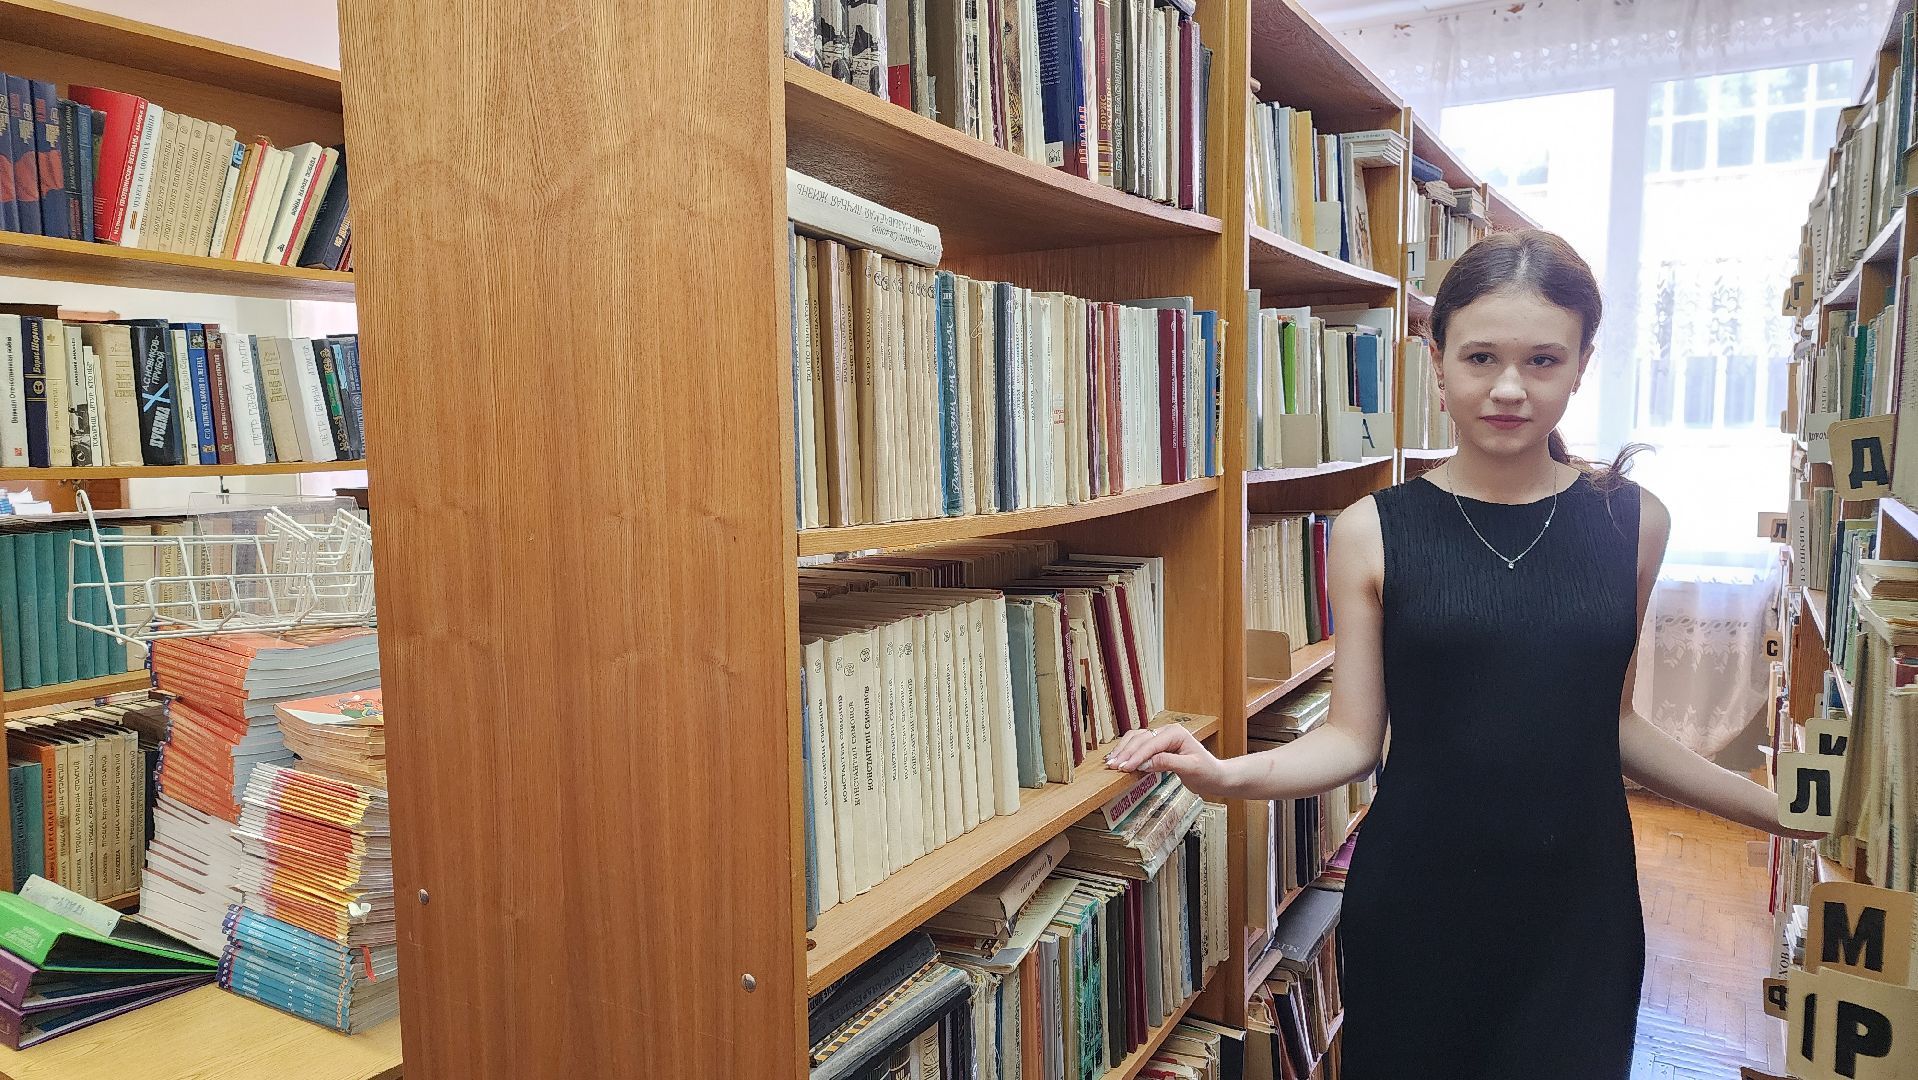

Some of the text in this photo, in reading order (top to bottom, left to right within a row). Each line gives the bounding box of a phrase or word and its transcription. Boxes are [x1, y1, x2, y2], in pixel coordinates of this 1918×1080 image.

[1099, 93, 1108, 131] БОРИС
[132, 184, 143, 207] ЧУДЕСА
[143, 114, 156, 139] ВОЙНЫ
[795, 181, 830, 201] ЖИЗНЬ
[830, 194, 863, 213] ЛИЧНАЯ
[864, 206, 913, 231] НАЗЫВАЕМАЯ
[869, 221, 937, 254] Константин Симонов
[1794, 282, 1804, 300] Г
[28, 321, 42, 373] Борис Шергин
[86, 375, 94, 388] КТО
[149, 351, 167, 384] ПРИБОЙ
[89, 415, 99, 447] ТОВАРИЩ
[148, 406, 170, 448] ЦУСИМА
[201, 403, 210, 426] ВЕЛИКИХ
[203, 428, 211, 439] СТО
[1849, 437, 1889, 490] Д
[1766, 639, 1778, 656] С
[848, 700, 860, 807] КОНСТАНТИН СИМОНОВ
[865, 729, 873, 792] КОНСТАНТИН
[1790, 768, 1831, 816] Л
[1822, 901, 1887, 973] М
[1835, 1001, 1893, 1079] Р
